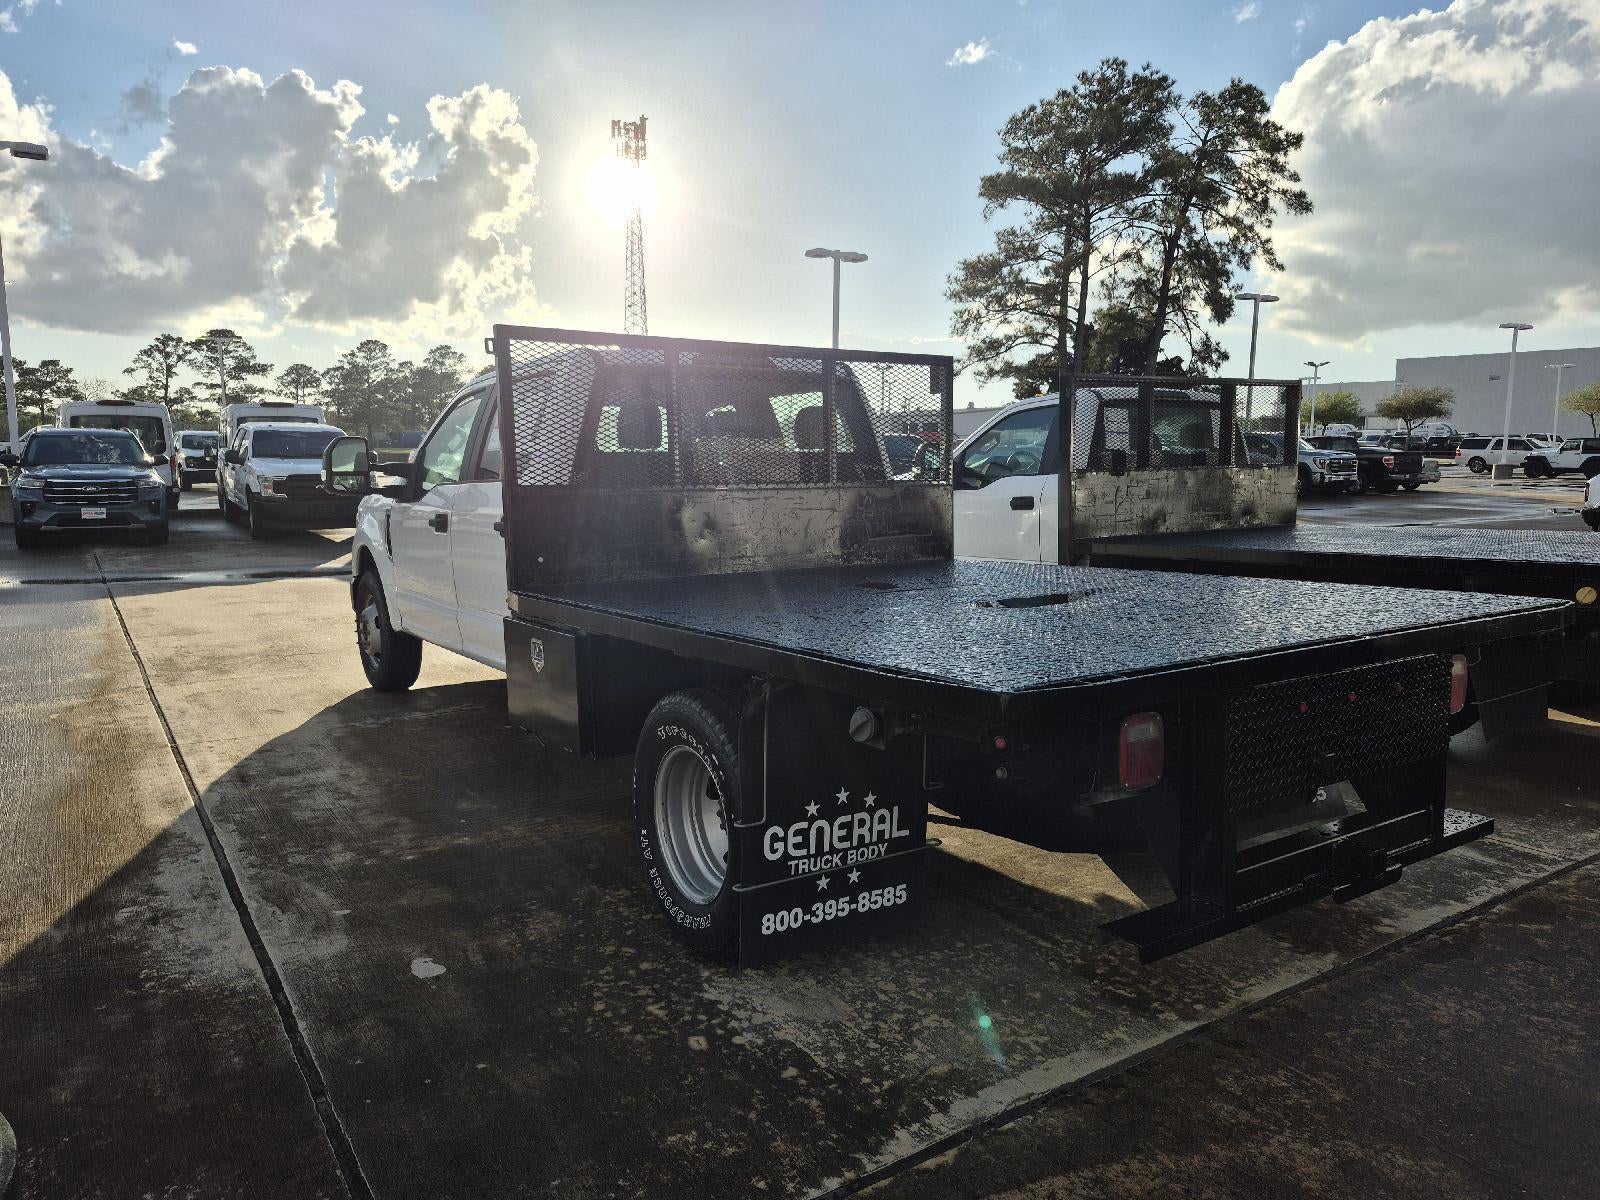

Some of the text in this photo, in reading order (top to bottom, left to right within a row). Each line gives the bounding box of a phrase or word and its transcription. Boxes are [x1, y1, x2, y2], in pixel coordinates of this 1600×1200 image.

[763, 806, 910, 861] GENERAL
[787, 842, 888, 876] TRUCK BODY
[761, 884, 907, 936] 800-395-8585
